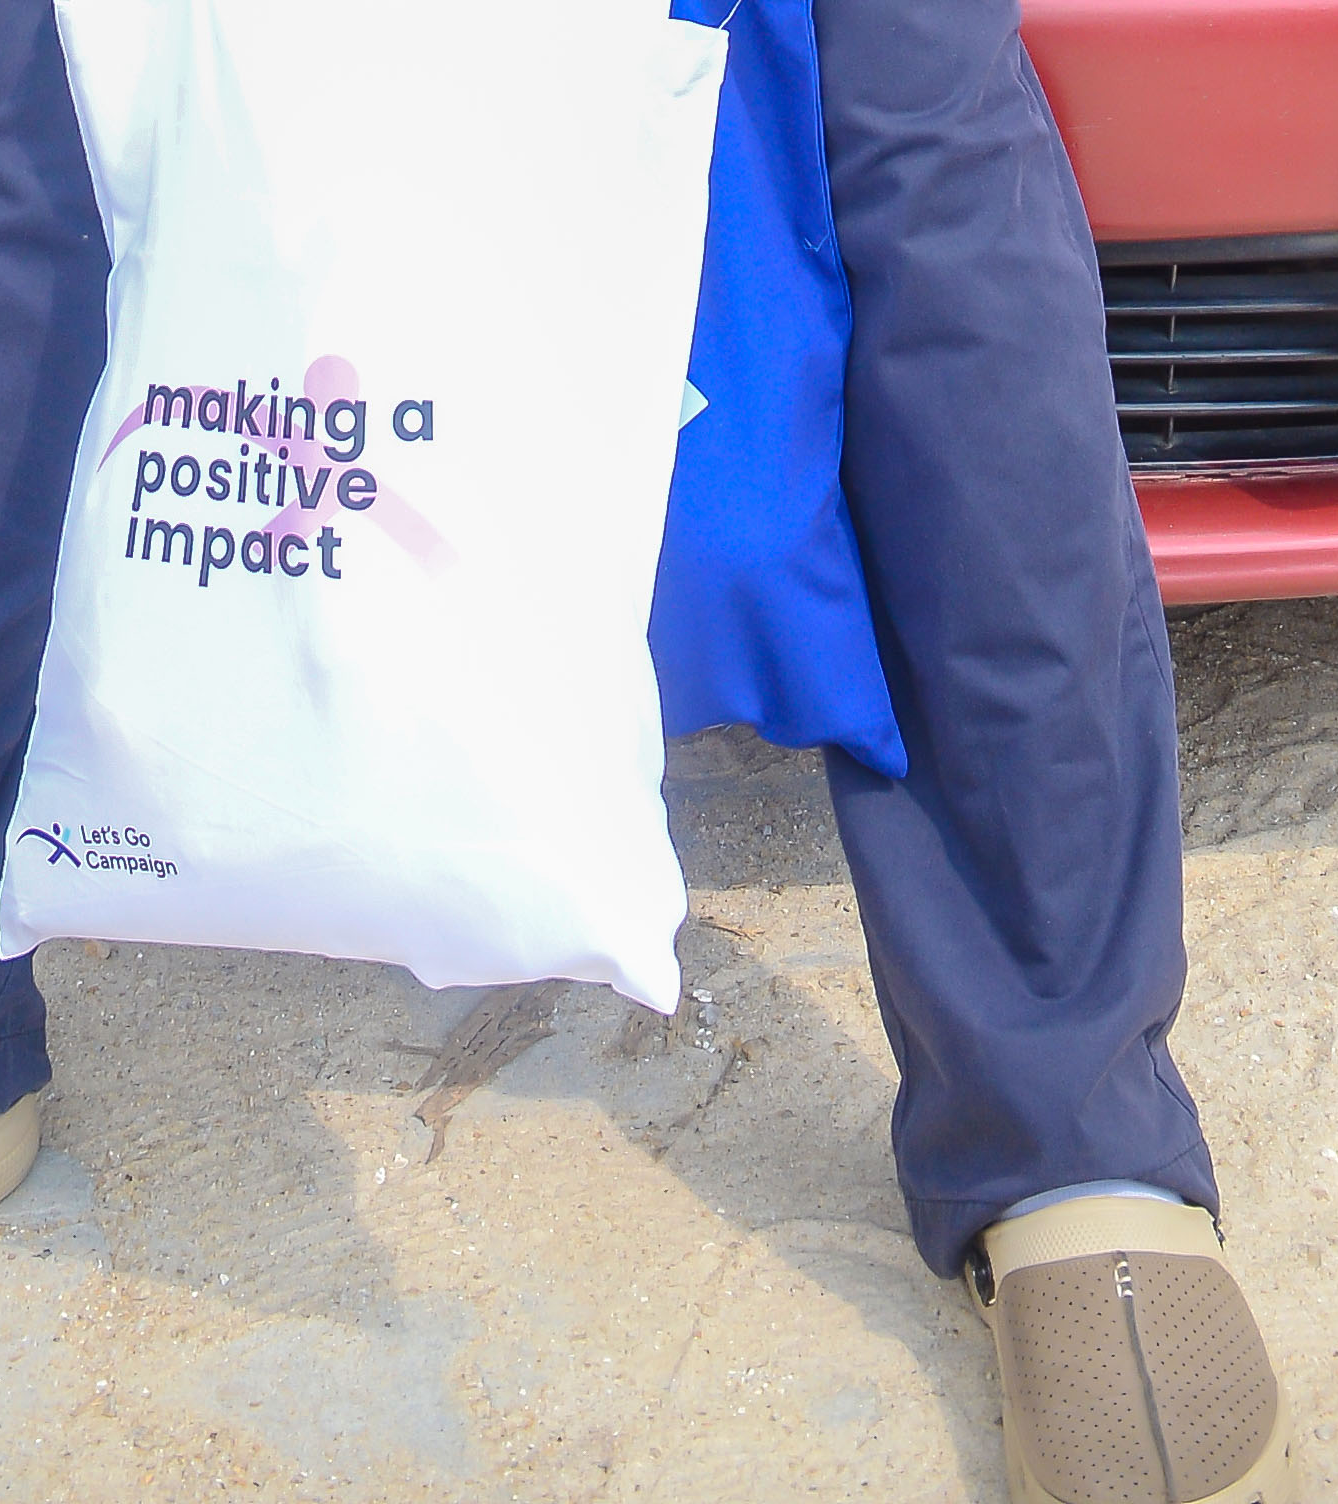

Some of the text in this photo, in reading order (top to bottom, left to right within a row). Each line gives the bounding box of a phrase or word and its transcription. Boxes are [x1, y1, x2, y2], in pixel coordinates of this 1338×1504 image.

[142, 377, 434, 463] making a
[131, 443, 378, 512] positive
[125, 516, 342, 587] impact
[79, 825, 151, 848] Let's Go
[85, 850, 179, 879] Campaign
